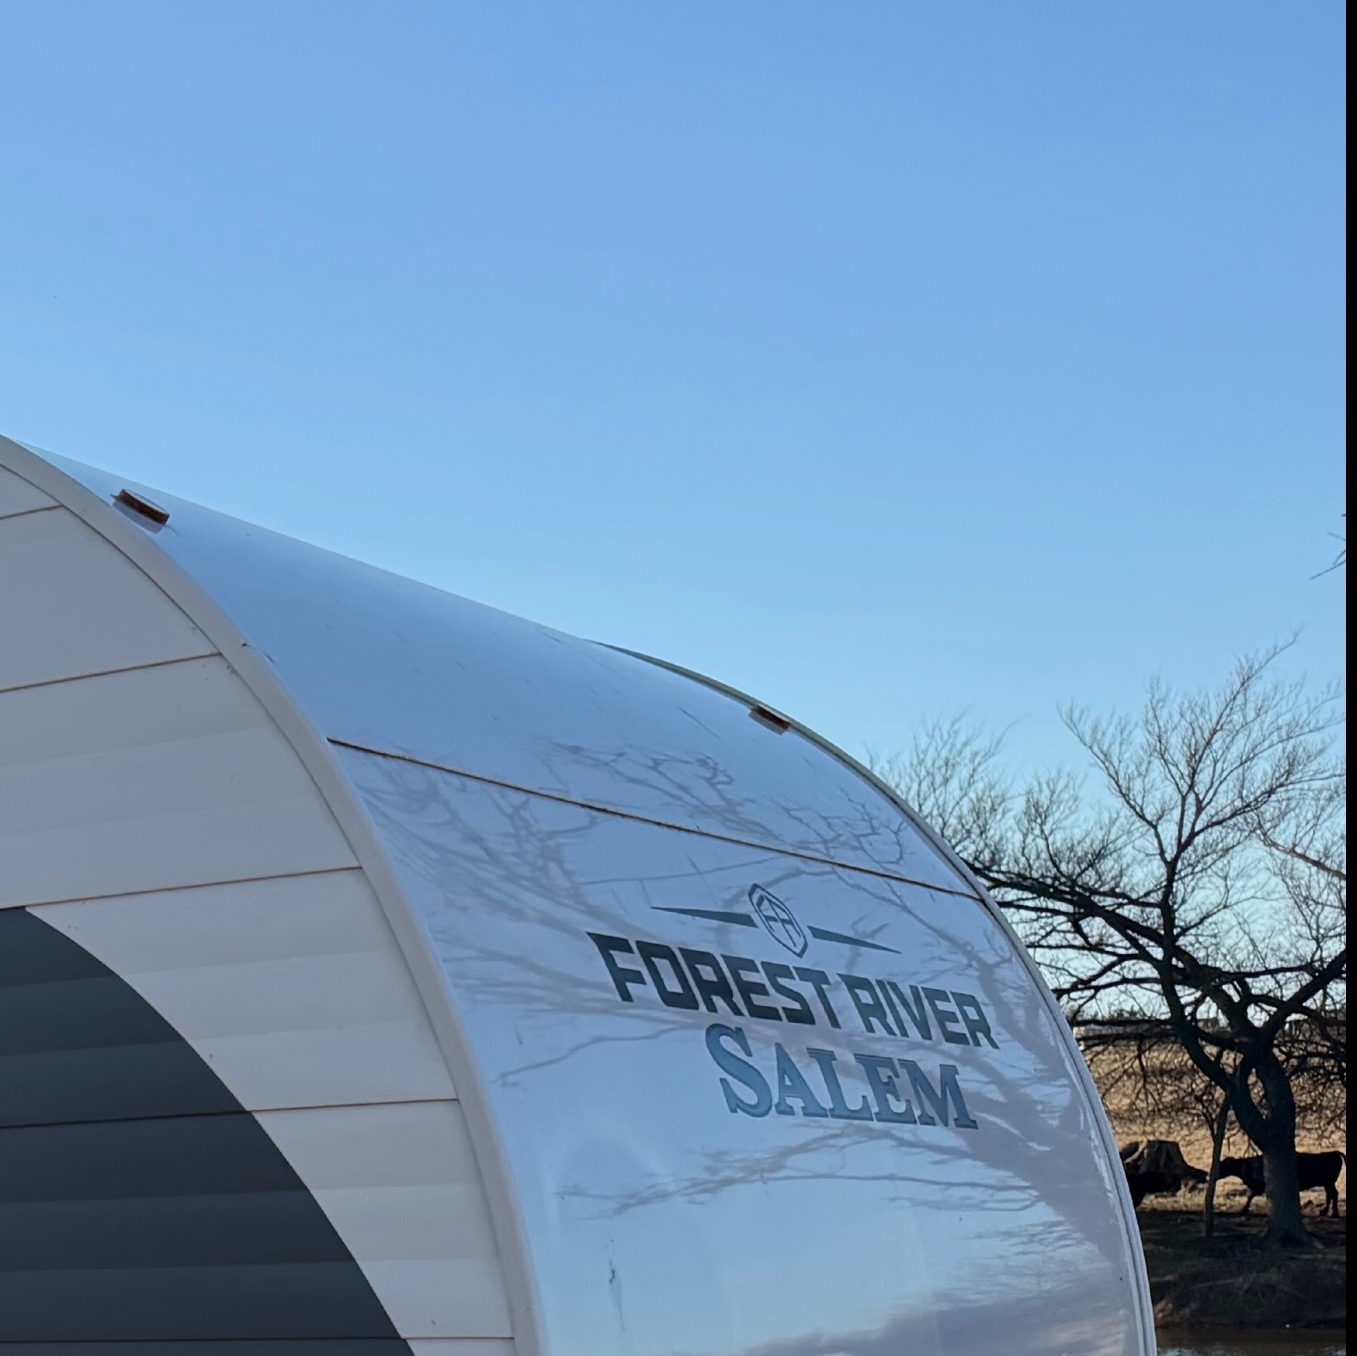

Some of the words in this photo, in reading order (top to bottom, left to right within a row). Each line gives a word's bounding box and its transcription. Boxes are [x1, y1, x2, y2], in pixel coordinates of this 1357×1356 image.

[586, 931, 842, 1029] FOREST
[836, 972, 1000, 1050] RIVER
[705, 1023, 979, 1130] SALEM
